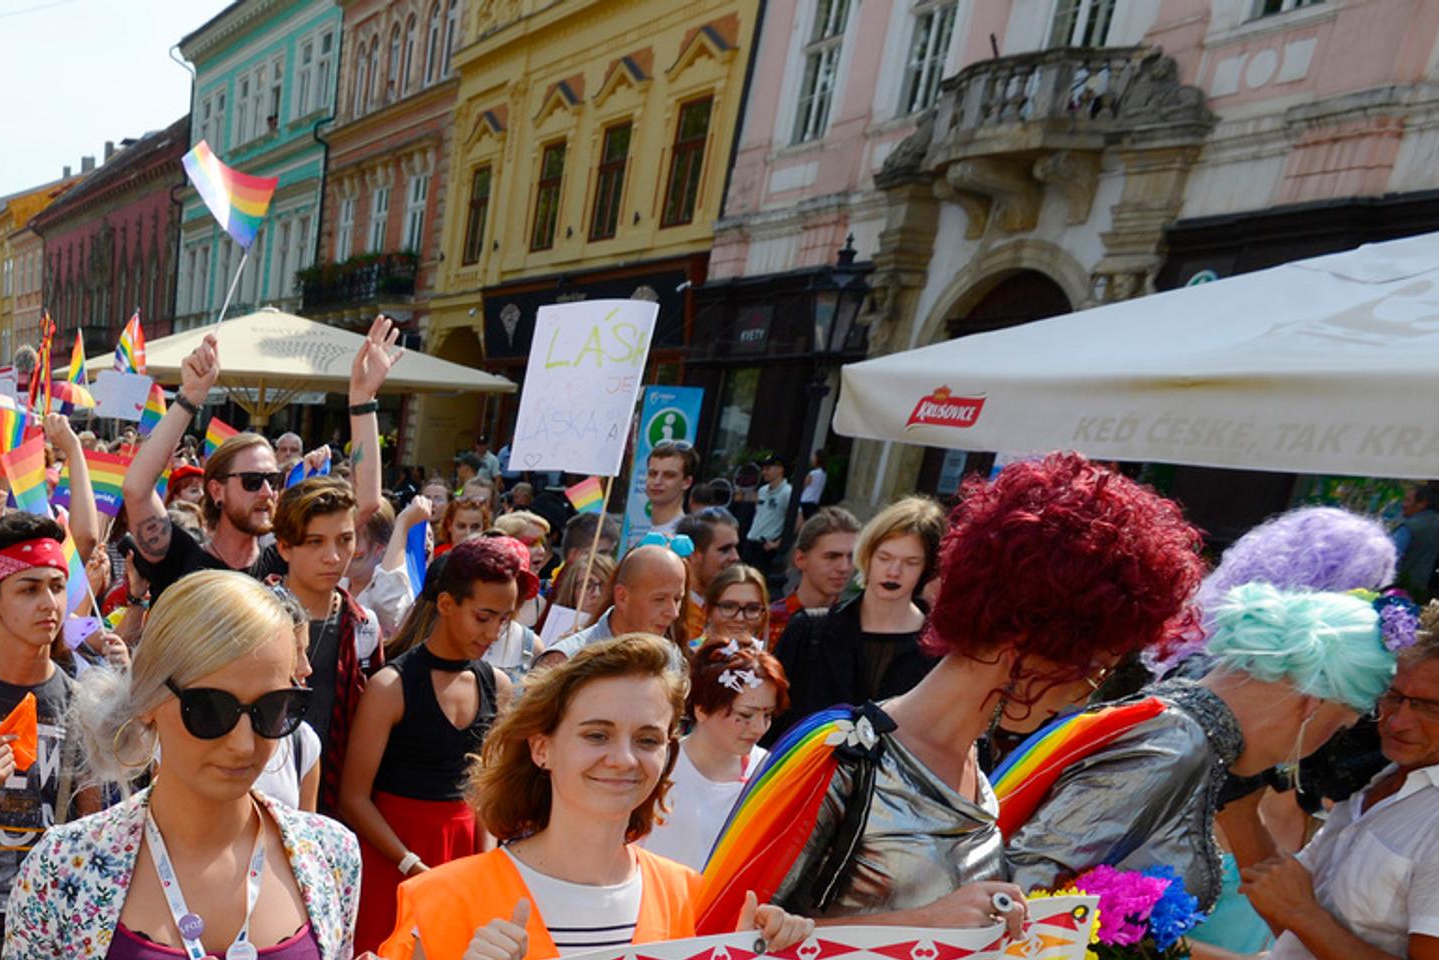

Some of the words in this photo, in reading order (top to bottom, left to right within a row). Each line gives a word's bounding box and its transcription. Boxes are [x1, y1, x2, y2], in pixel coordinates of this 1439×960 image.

[606, 376, 635, 394] JE
[1071, 411, 1140, 444] KEĎ
[1271, 422, 1354, 455] TAK
